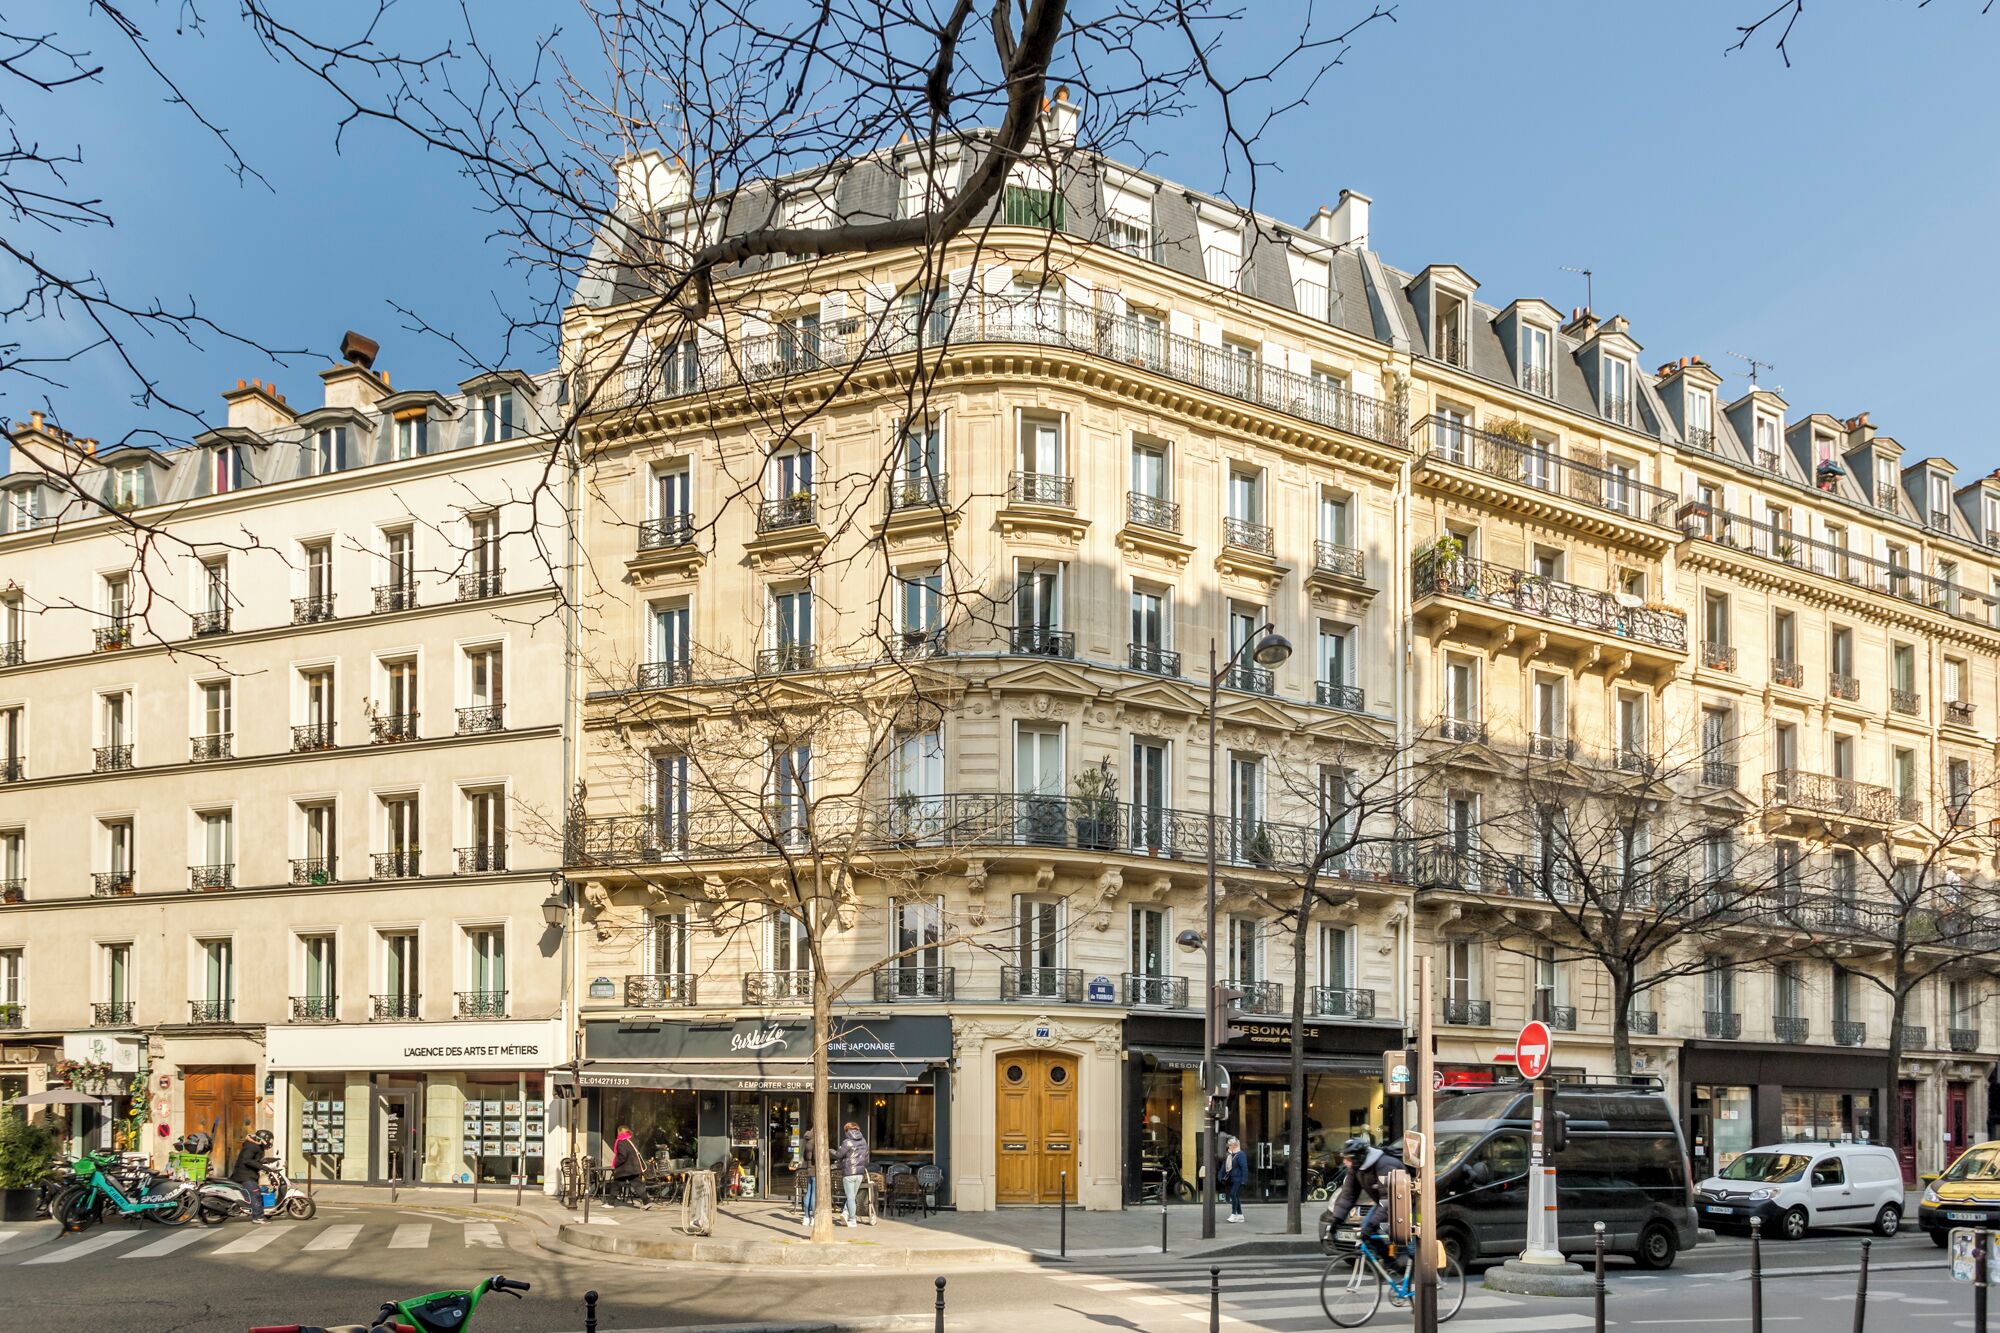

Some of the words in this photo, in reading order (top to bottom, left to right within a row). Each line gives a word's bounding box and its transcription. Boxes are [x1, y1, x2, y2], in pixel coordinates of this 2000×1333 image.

[1037, 1028, 1048, 1037] 77
[1231, 1025, 1319, 1037] RESONACE
[731, 1023, 787, 1051] SushiZo
[404, 1047, 444, 1056] L'AGENCE
[445, 1047, 463, 1056] DES
[464, 1046, 487, 1056] ARTS
[488, 1046, 499, 1055] ET
[500, 1044, 538, 1055] MÉTIERS
[580, 1076, 630, 1085] EL:0142711313
[744, 1081, 782, 1089] EMPORTER
[834, 1082, 871, 1090] LIVRAISON
